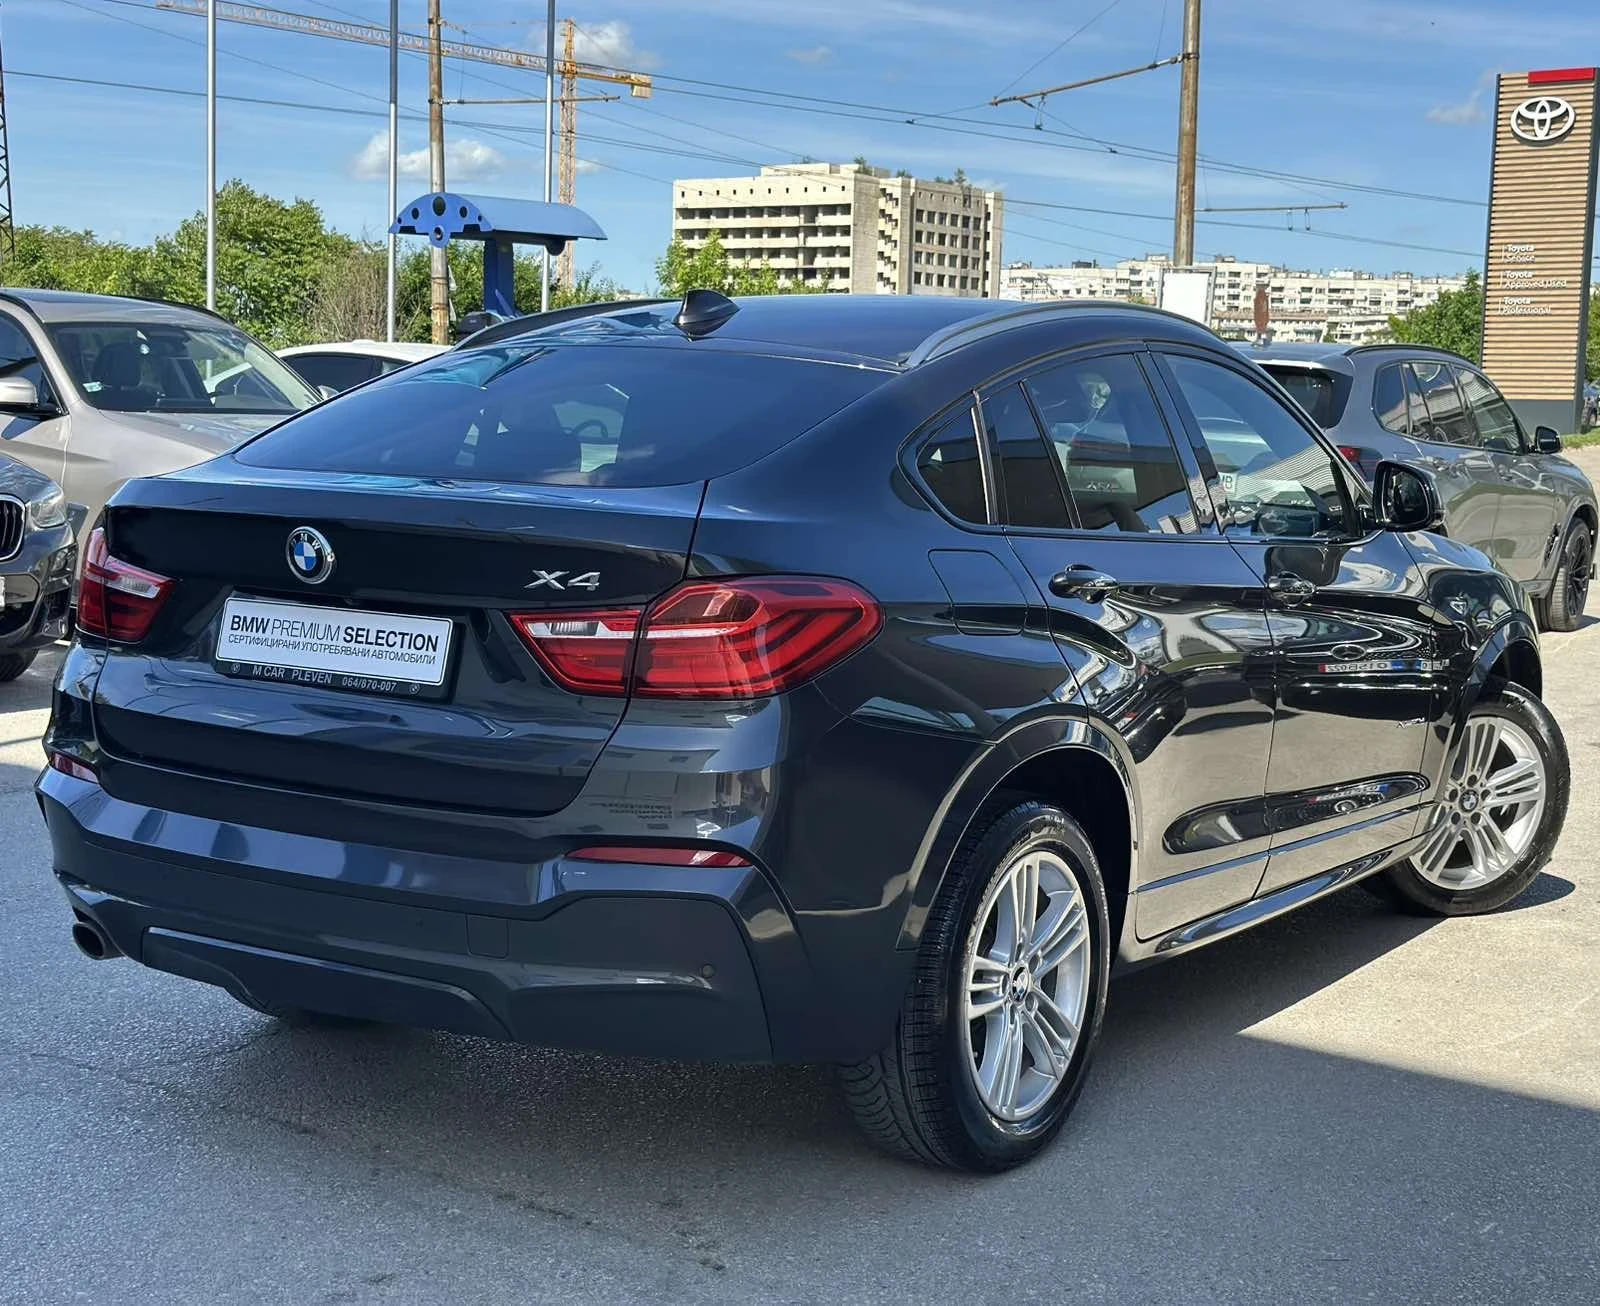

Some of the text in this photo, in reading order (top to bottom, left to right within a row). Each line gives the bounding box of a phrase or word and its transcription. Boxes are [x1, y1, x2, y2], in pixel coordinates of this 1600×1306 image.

[1507, 244, 1534, 253] Toyota
[1505, 271, 1533, 280] Toyota
[1503, 297, 1531, 306] Toyota
[523, 570, 601, 591] X4
[230, 615, 439, 652] BMW PREMIUM SELECTION
[228, 634, 436, 664] СЕРТИФИЦИРАНИ УПОТРЕБЯВАНИ АВТОМОБИЛИ
[252, 665, 397, 692] M CAR PLEVEN 064/870-007
